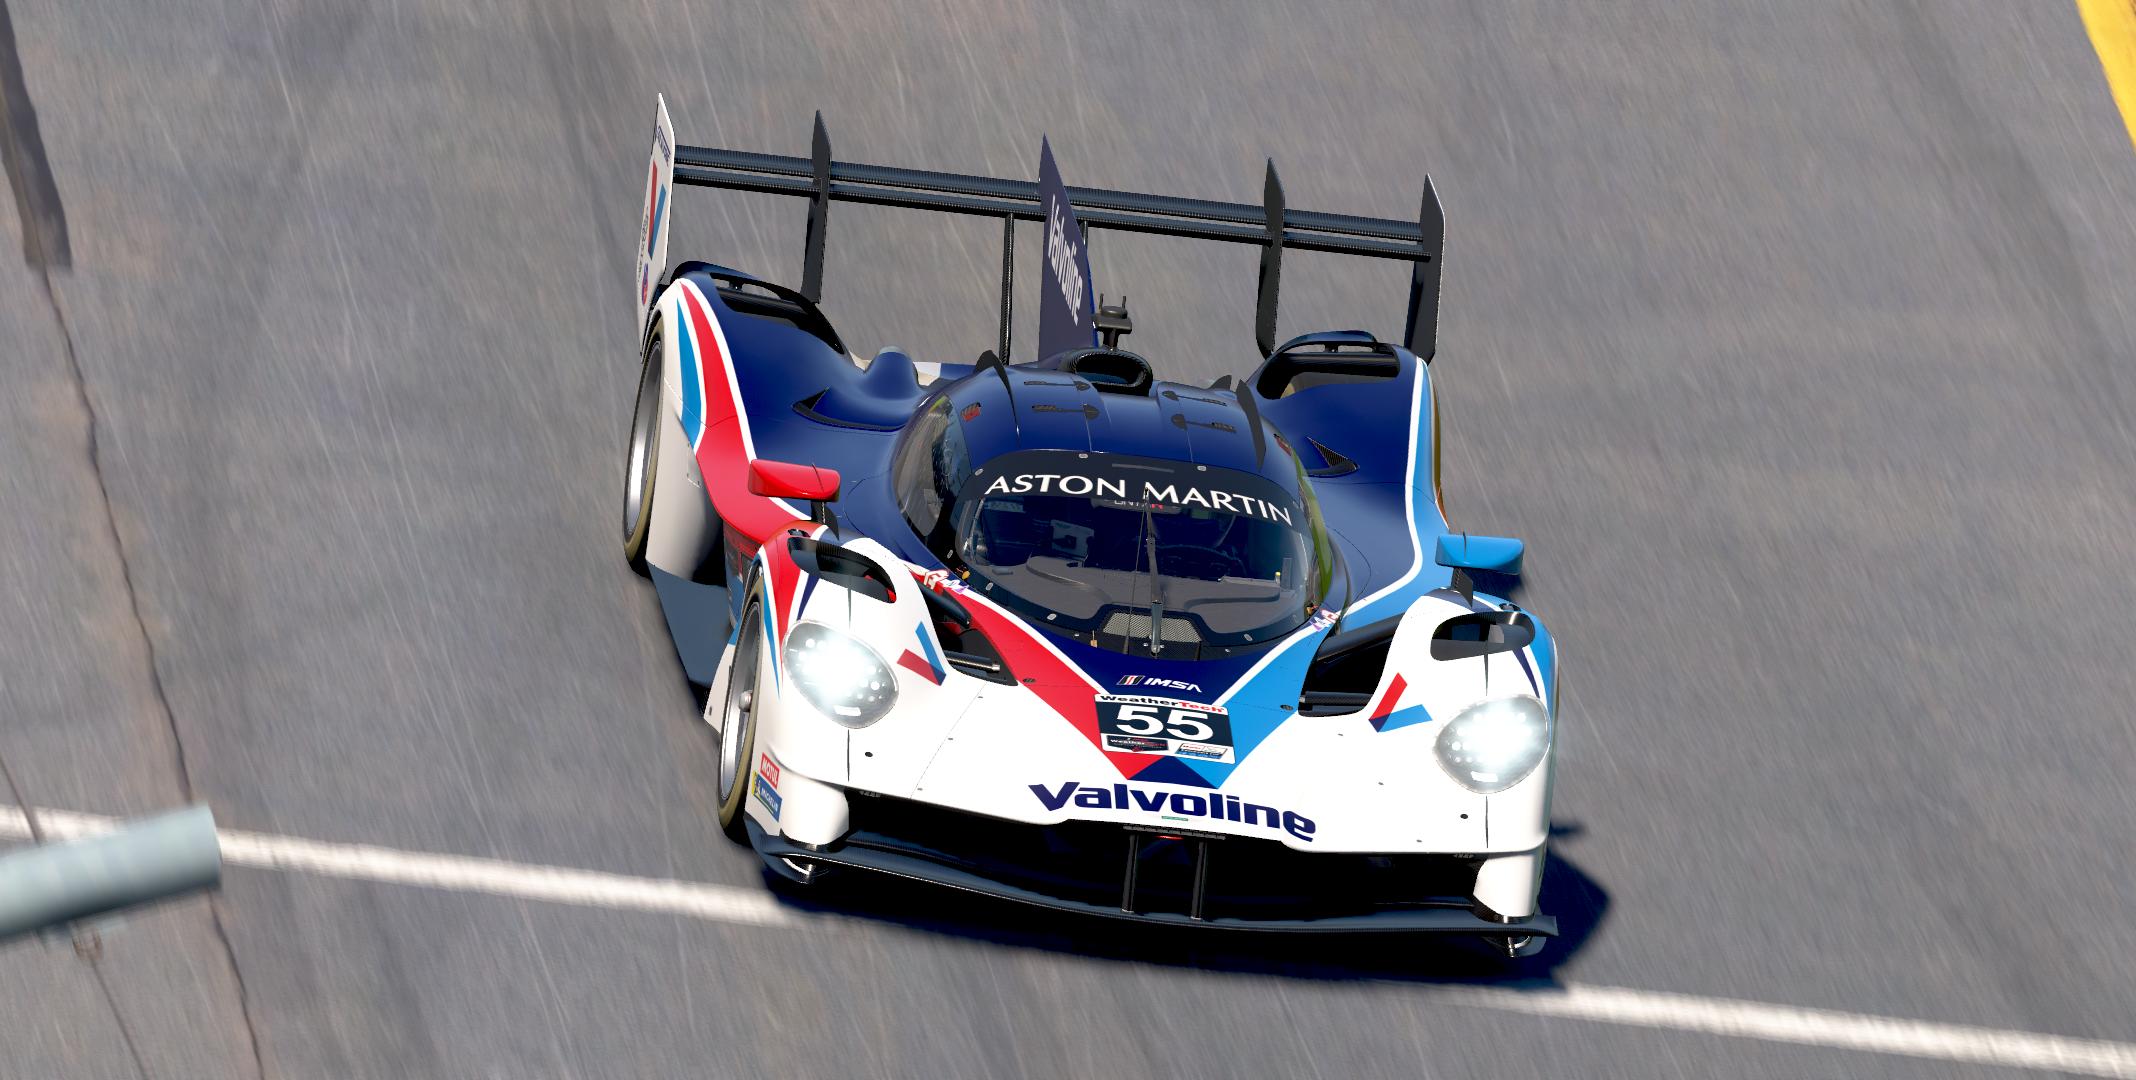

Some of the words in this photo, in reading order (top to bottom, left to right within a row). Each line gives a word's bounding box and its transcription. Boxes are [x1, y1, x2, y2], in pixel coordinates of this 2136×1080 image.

[1047, 193, 1083, 326] Valvoline
[984, 474, 1126, 498] ASTON
[1143, 481, 1293, 527] MARTIN
[1144, 677, 1202, 693] IMSA
[1099, 695, 1225, 713] WeatherTech
[1116, 704, 1214, 741] 55
[761, 757, 779, 786] MOTUL
[1028, 781, 1317, 843] Valvoline
